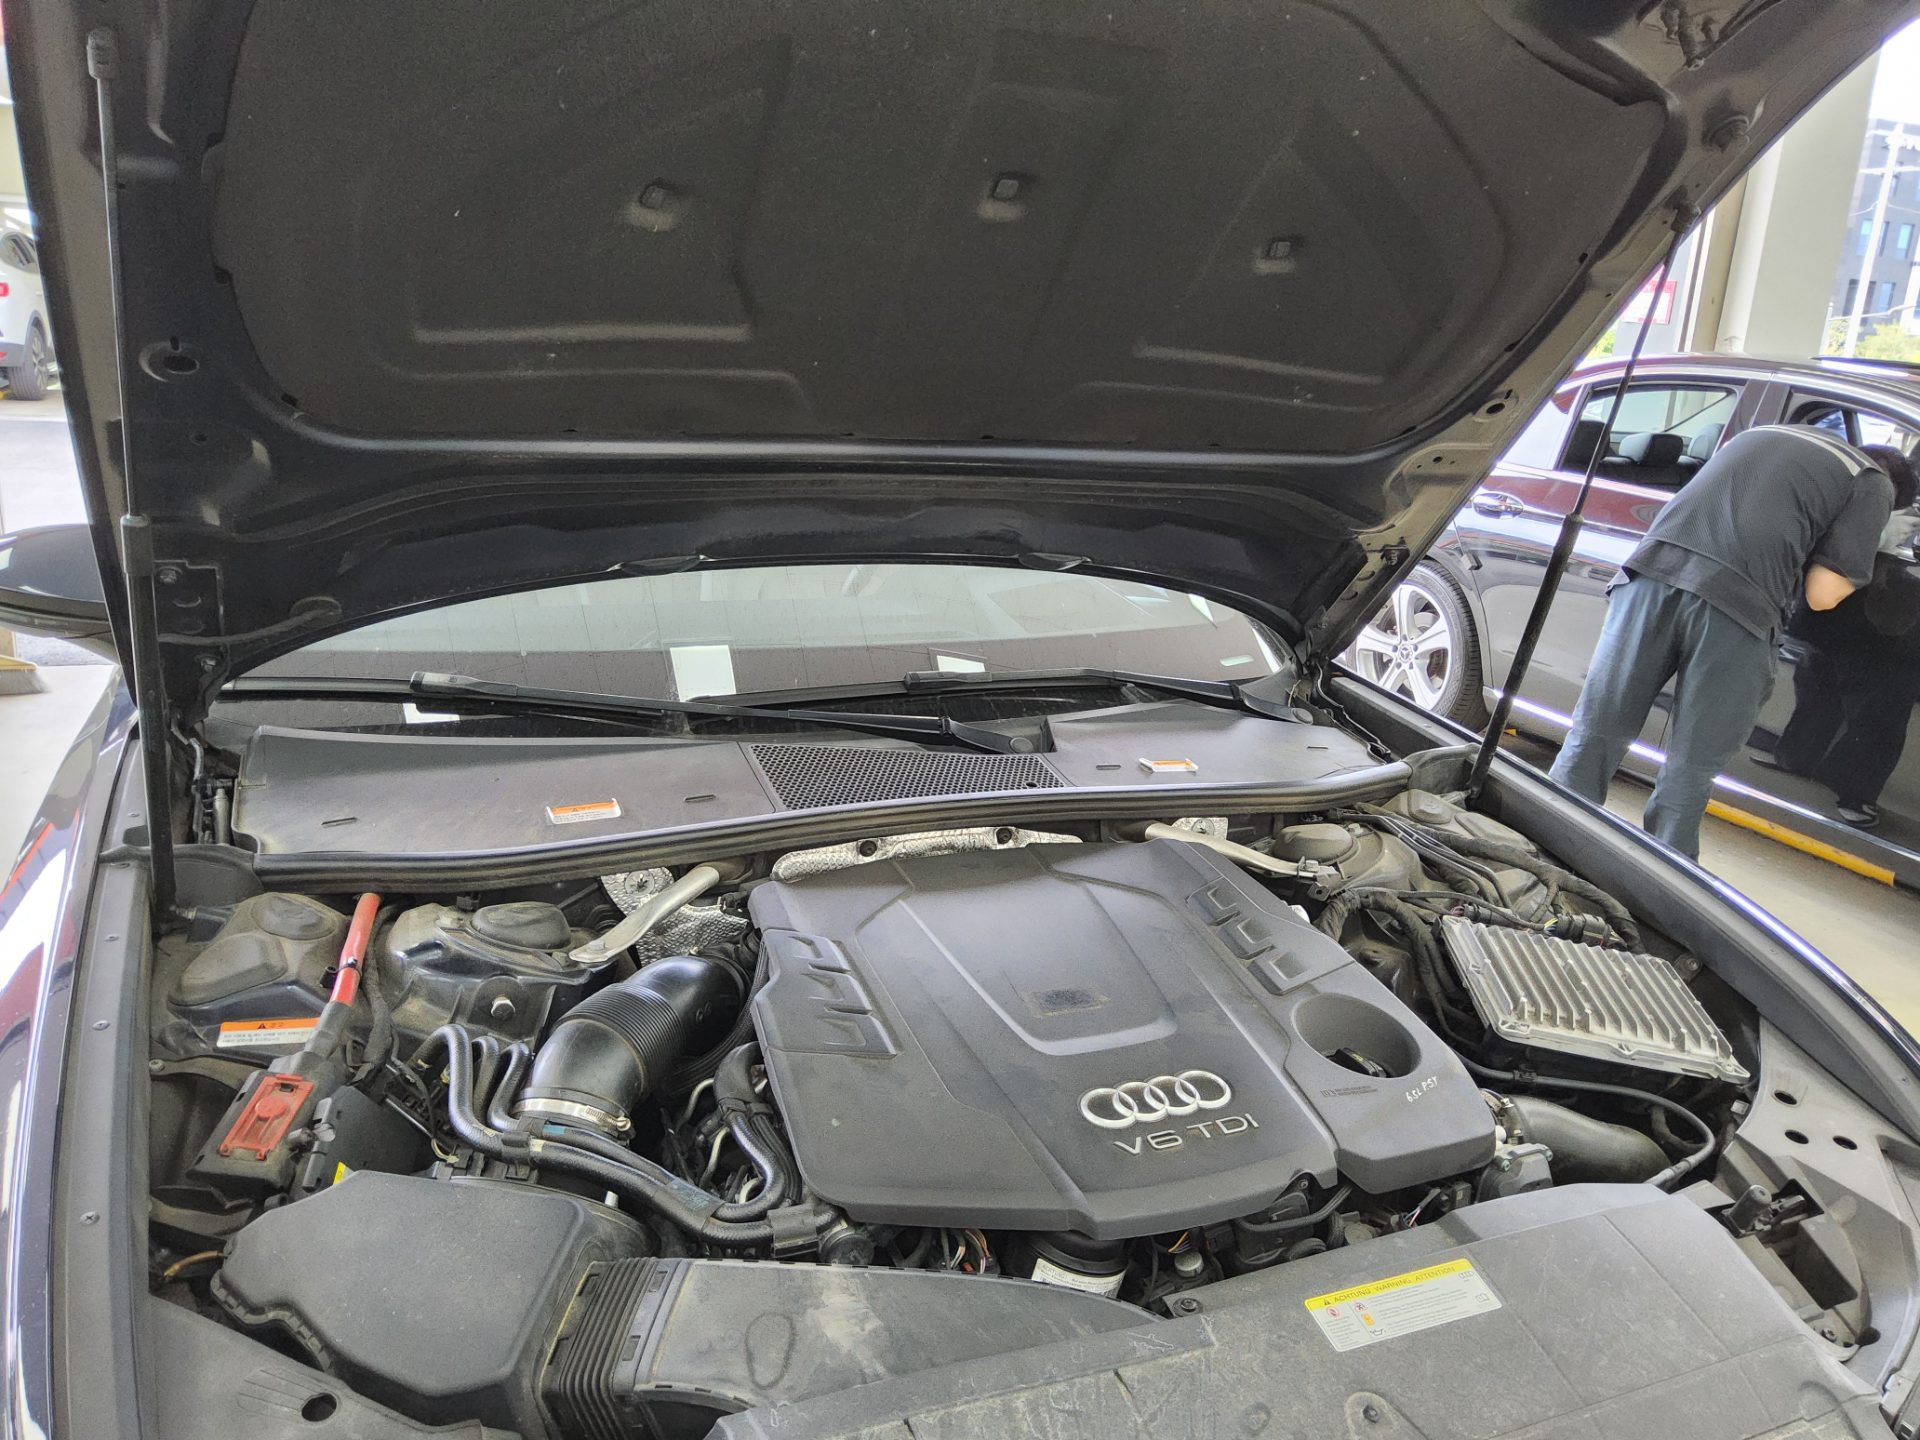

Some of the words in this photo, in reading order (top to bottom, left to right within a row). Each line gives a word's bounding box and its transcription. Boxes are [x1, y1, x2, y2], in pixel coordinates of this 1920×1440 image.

[1113, 1129, 1183, 1155] V6
[1186, 1113, 1260, 1139] TDI
[1333, 1289, 1371, 1303] ACHTUNG
[1374, 1278, 1412, 1292] WARNING
[1414, 1267, 1455, 1282] ATTENTION
